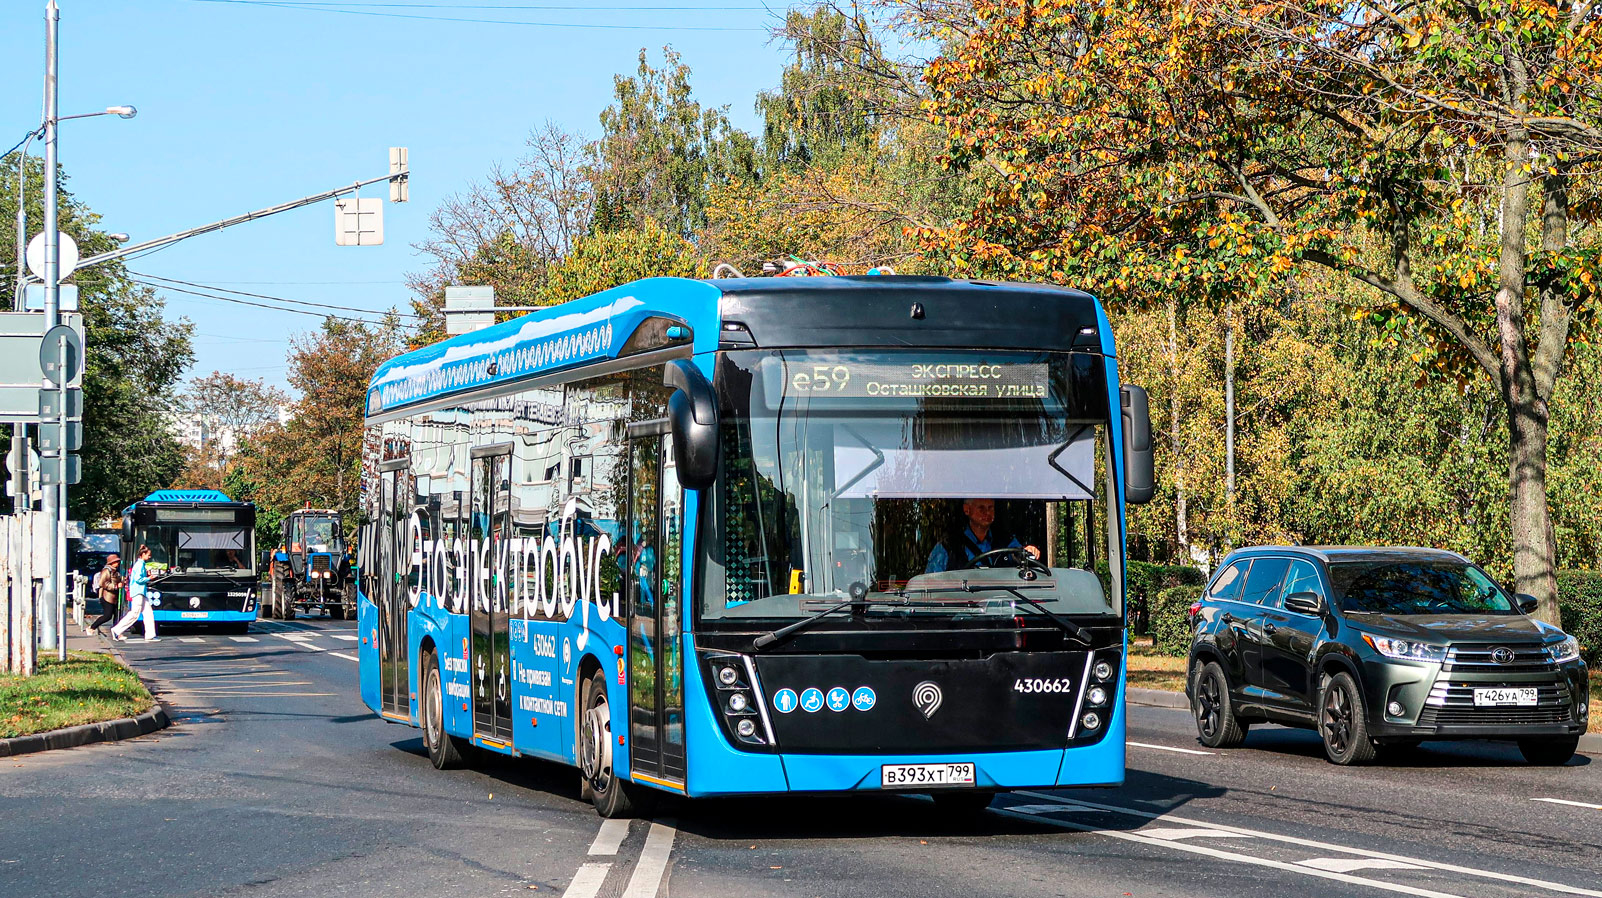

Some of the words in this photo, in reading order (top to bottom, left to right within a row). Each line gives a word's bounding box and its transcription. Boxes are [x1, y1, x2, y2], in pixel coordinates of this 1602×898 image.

[911, 364, 1002, 379] ЭКСПРЕСС
[866, 381, 988, 396] Осташковская
[995, 384, 1046, 398] улица
[408, 512, 446, 610] Это
[533, 634, 556, 658] 430662
[518, 663, 526, 683] Не
[526, 669, 551, 689] привязан
[1014, 679, 1071, 693] 430662
[1478, 690, 1518, 701] Т426УА
[1519, 688, 1535, 698] 799
[524, 695, 554, 715] контактной
[554, 701, 567, 717] сети
[888, 767, 944, 783] В393ХТ
[948, 765, 970, 777] 799
